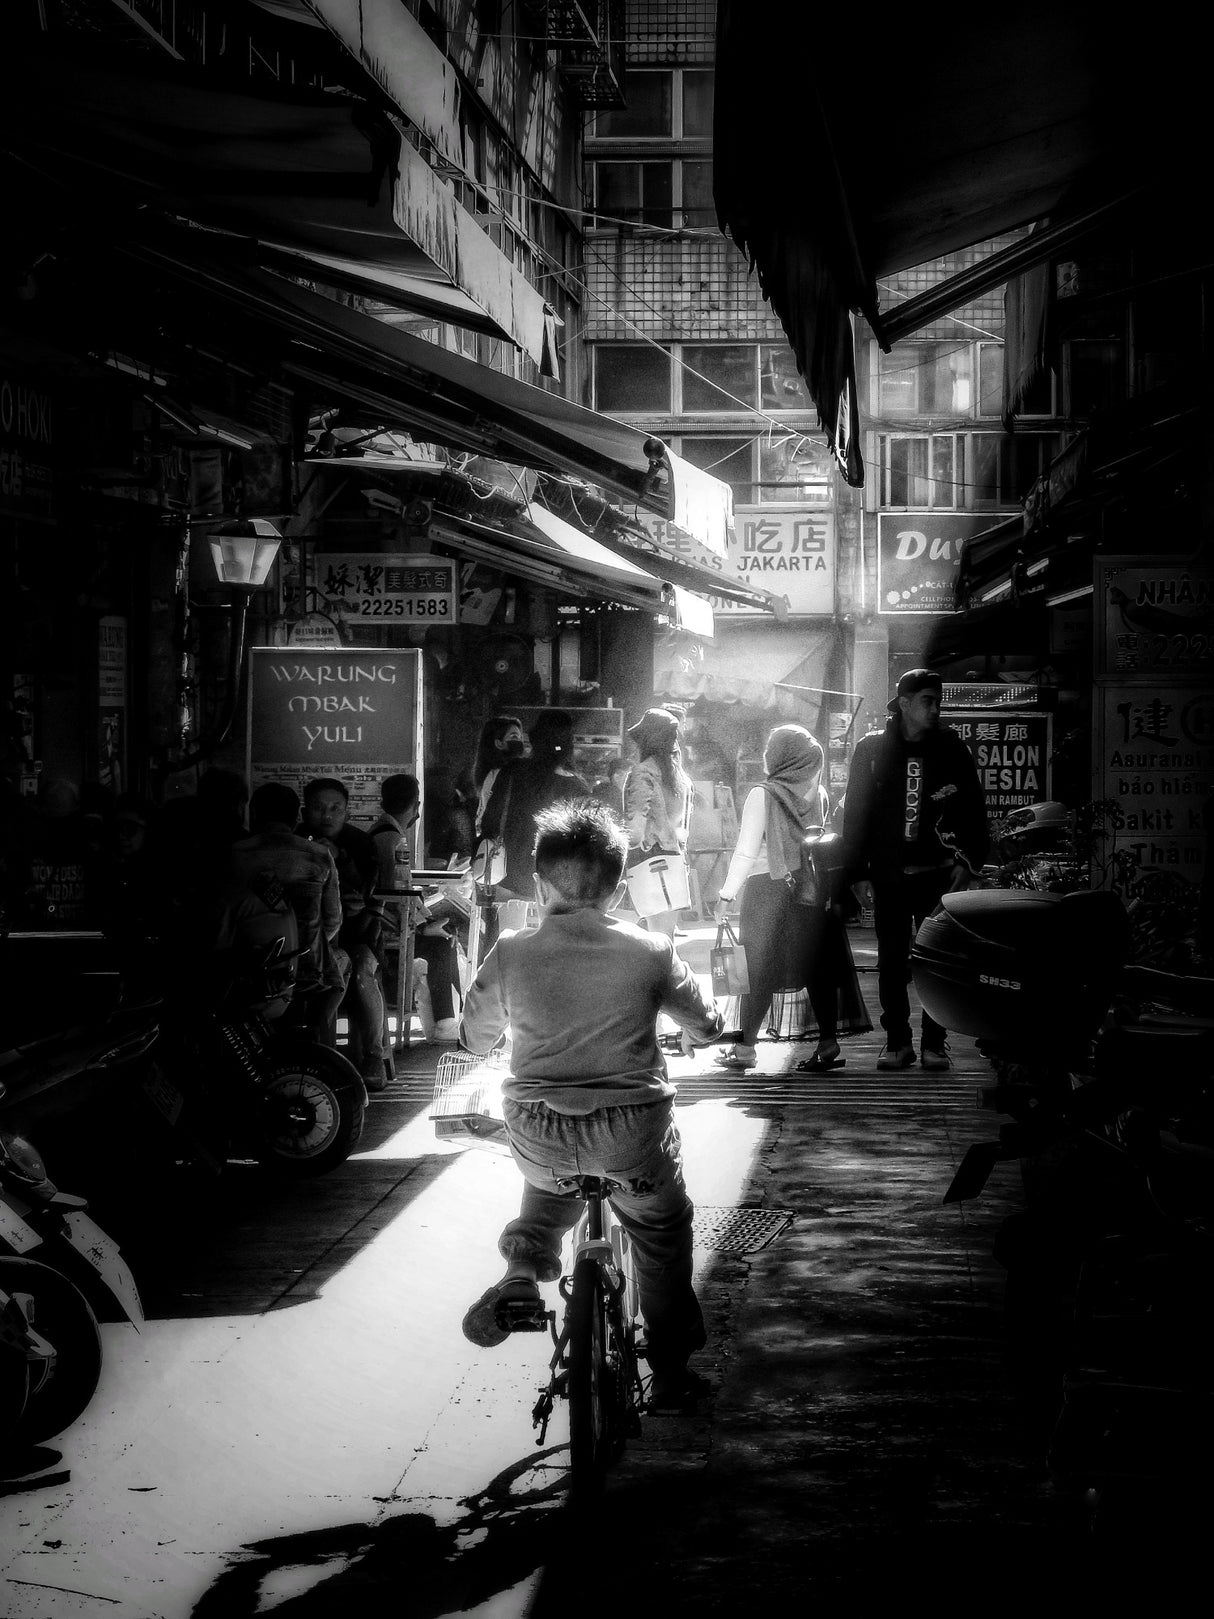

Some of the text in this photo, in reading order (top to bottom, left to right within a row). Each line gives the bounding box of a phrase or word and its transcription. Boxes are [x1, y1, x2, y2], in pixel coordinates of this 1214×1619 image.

[736, 555, 827, 571] JAKARTA
[361, 599, 449, 616] 22251583
[270, 665, 396, 685] WARUNG
[288, 695, 376, 712] MBAK
[1117, 698, 1180, 747] 健
[302, 726, 362, 750] YULI
[977, 745, 1040, 767] SALON
[905, 761, 922, 838] GUCCI
[1000, 795, 1035, 805] RAMBUT
[980, 975, 1021, 990] SH33
